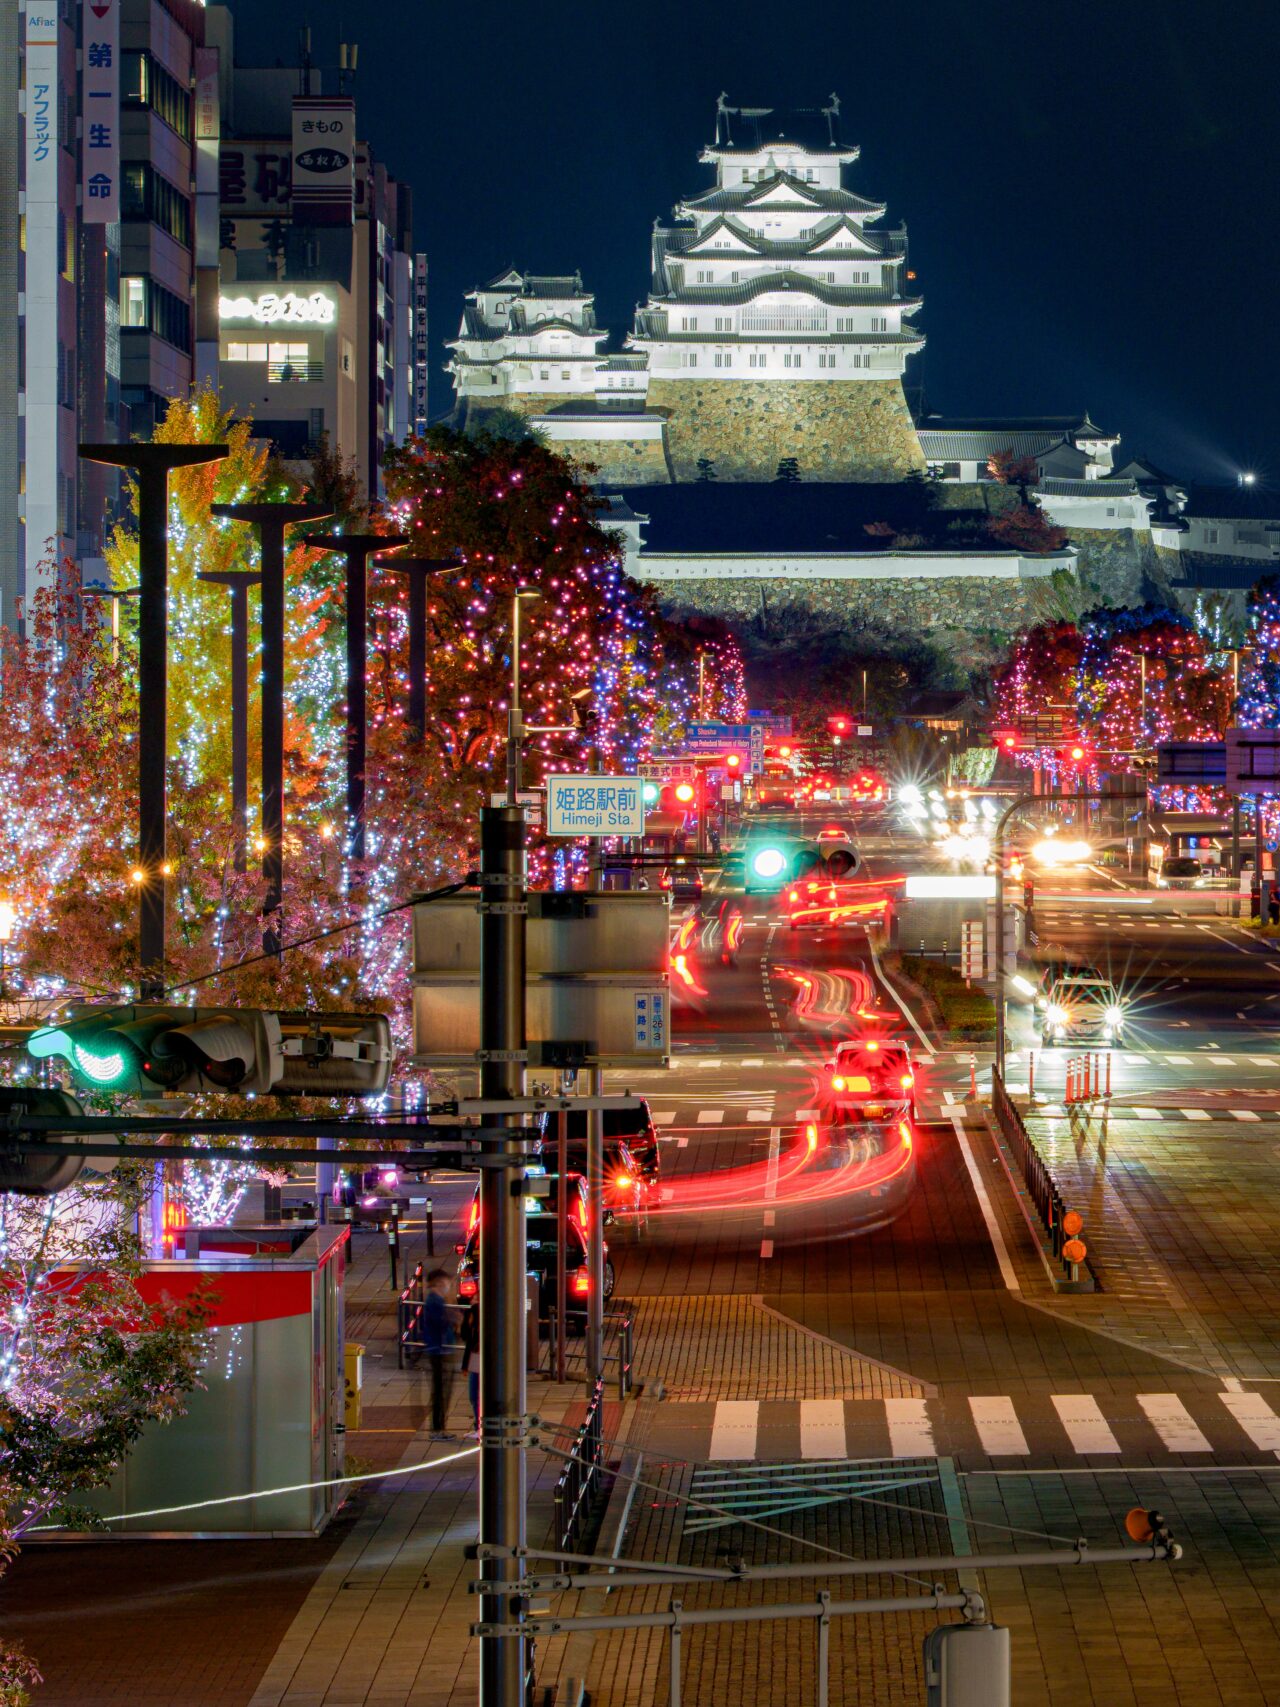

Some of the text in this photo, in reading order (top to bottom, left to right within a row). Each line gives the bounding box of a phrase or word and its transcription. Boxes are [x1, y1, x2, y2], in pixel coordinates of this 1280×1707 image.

[29, 17, 55, 27] Aflac
[33, 84, 50, 162] アフラック
[88, 42, 112, 199] 第一生命
[302, 120, 343, 134] きもの
[638, 765, 692, 778] 時差式信号
[556, 787, 637, 811] 姫路駅前
[562, 812, 634, 827] Himeji Sta.
